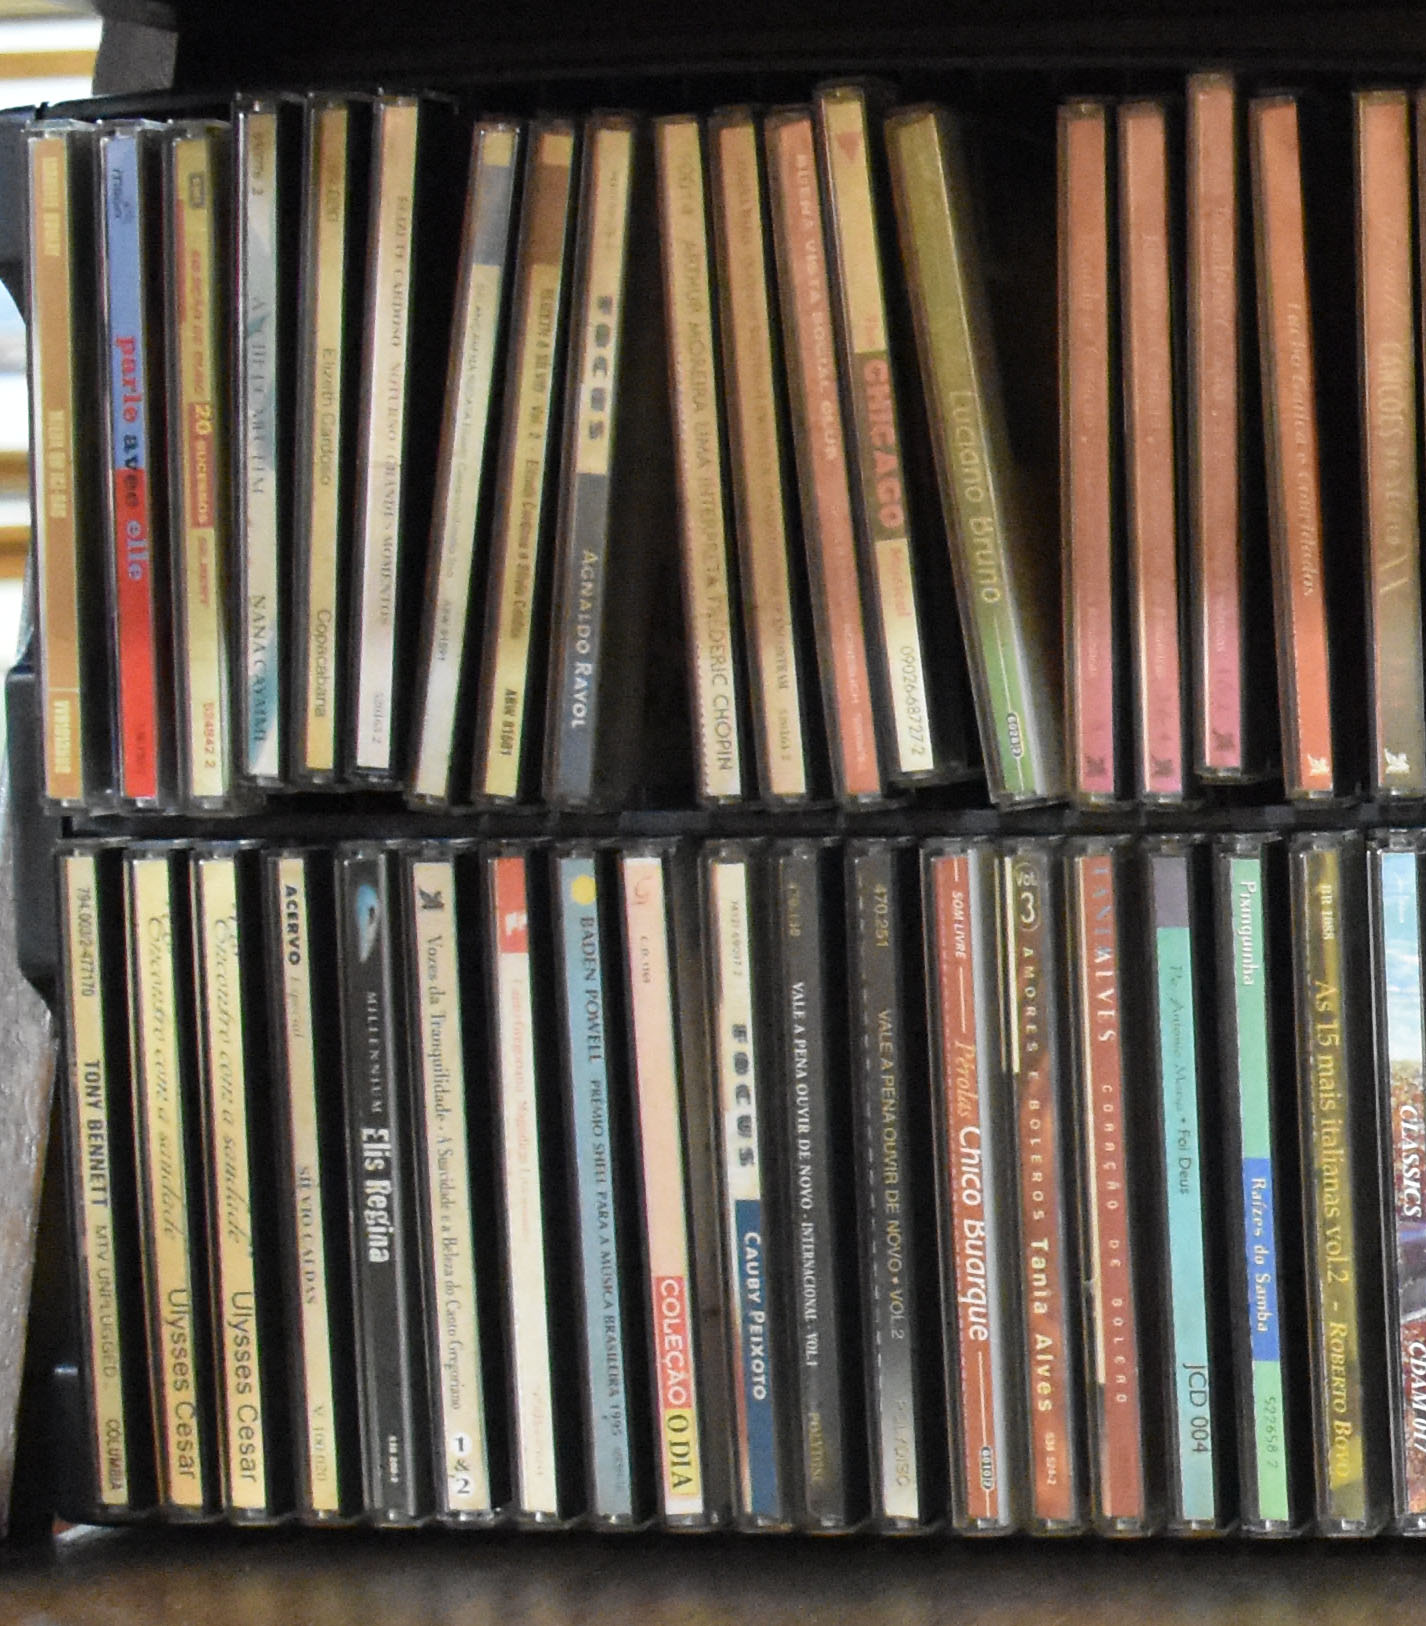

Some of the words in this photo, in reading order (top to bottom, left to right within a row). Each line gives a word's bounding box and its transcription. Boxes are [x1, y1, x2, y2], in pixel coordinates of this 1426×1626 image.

[116, 336, 141, 422] parle
[123, 434, 140, 507] avec
[863, 359, 905, 528] CHICAGO
[948, 391, 981, 499] Luciano
[969, 516, 1001, 604] Bruno
[128, 520, 149, 580] elle
[575, 550, 599, 654] AGNALDO
[313, 609, 332, 718] Copacabana
[571, 661, 593, 728] RAYOL
[284, 885, 301, 965] ACERVO
[1237, 880, 1259, 985] Pixinguinha
[1315, 980, 1337, 1012] As
[1317, 1021, 1339, 1046] 15
[83, 1061, 100, 1109] TONY
[1318, 1055, 1340, 1109] mais
[87, 1119, 108, 1207] BENNETT
[362, 1127, 392, 1170] Elis
[958, 1125, 986, 1206] Chico
[1321, 1117, 1344, 1217] italianas
[1399, 1104, 1423, 1218] CLASSICS
[363, 1179, 394, 1263] Regina
[1251, 1178, 1270, 1236] Raízes
[958, 1219, 990, 1341] Buarque
[1030, 1238, 1050, 1313] Tania
[1254, 1245, 1269, 1265] do
[1326, 1226, 1348, 1284] vol.2
[164, 1288, 193, 1392] Ulysses
[1255, 1272, 1271, 1332] Samba
[227, 1291, 258, 1395] Ulysses
[660, 1277, 688, 1406] COLEÇÃO
[1034, 1333, 1054, 1412] Alves
[667, 1414, 689, 1432] O
[1183, 1363, 1208, 1407] JCD
[174, 1402, 197, 1480] Cesar
[237, 1404, 259, 1483] Cesar
[669, 1440, 693, 1489] DIA
[1191, 1417, 1211, 1454] 004
